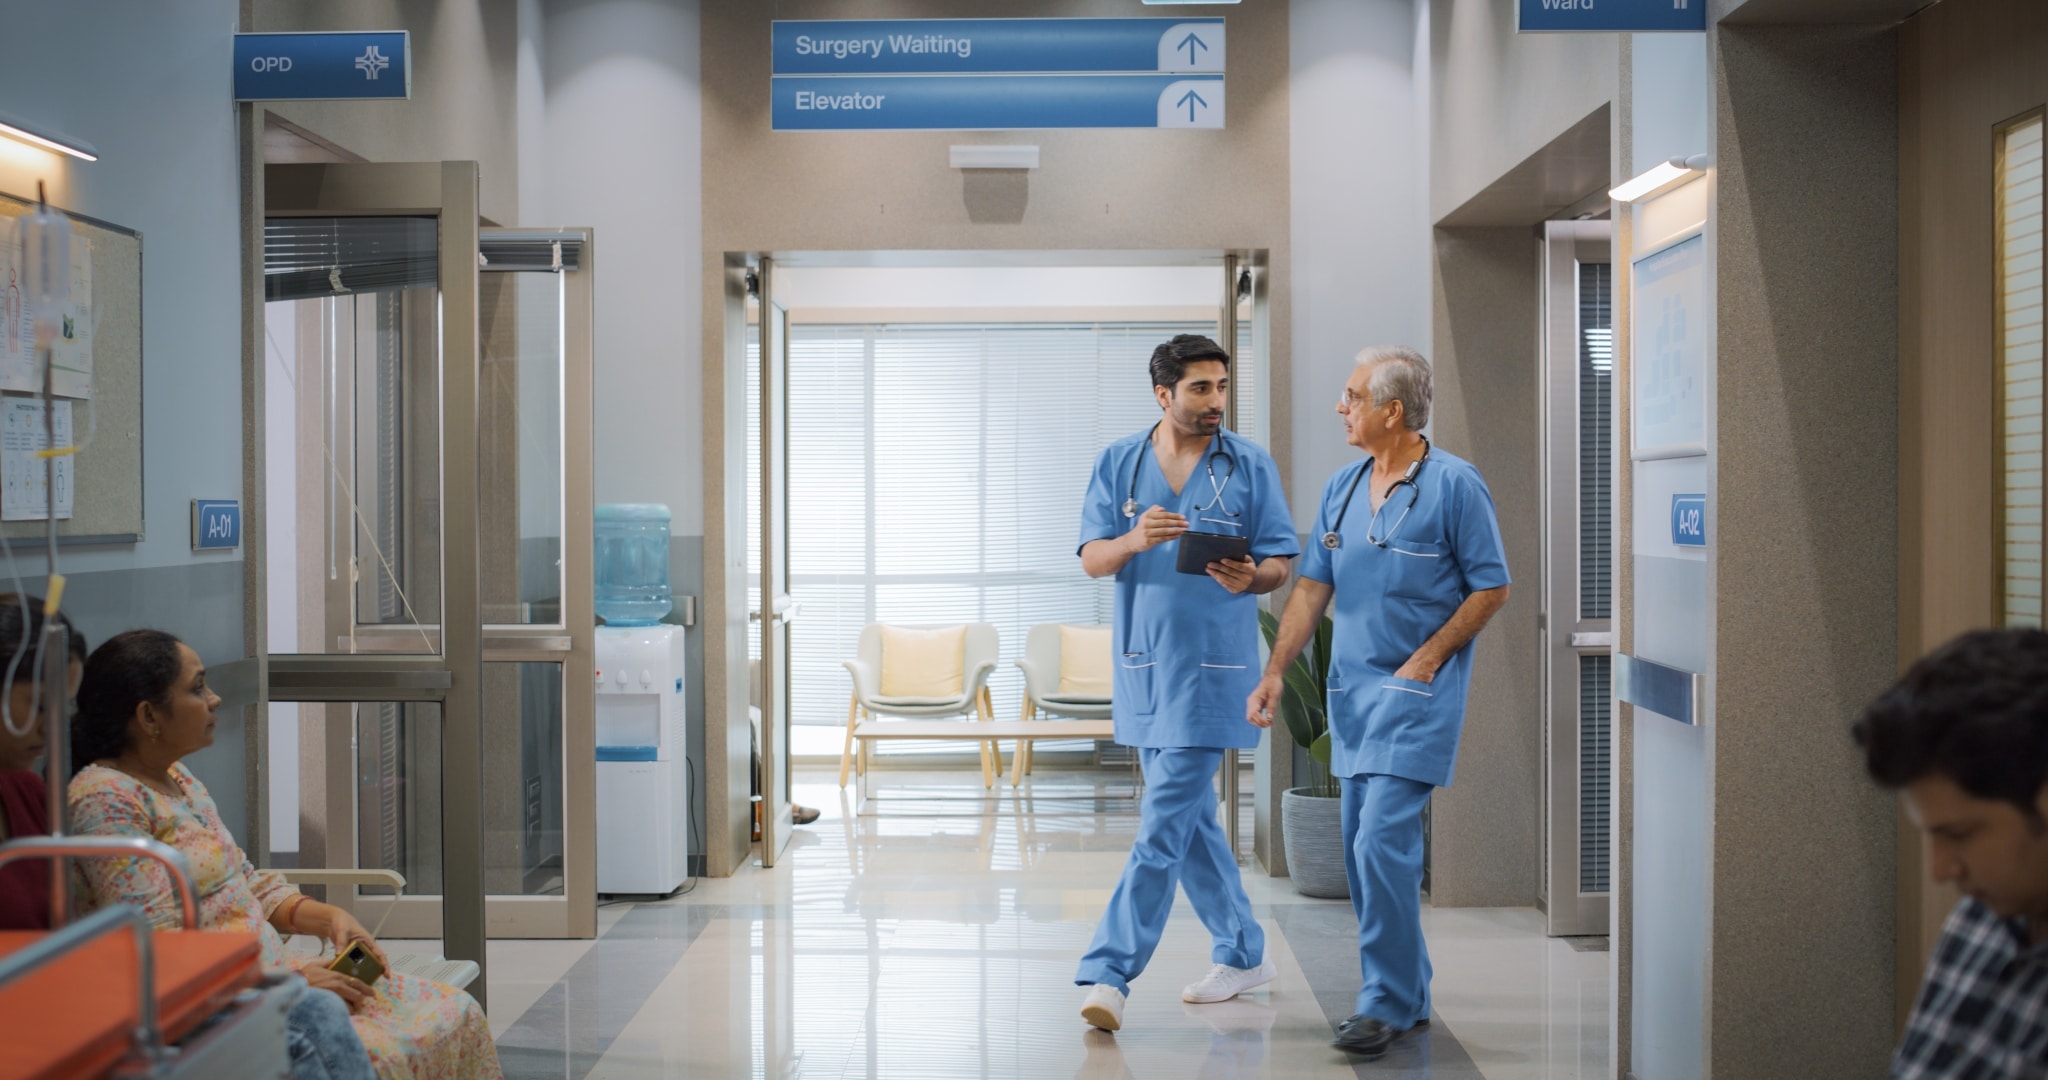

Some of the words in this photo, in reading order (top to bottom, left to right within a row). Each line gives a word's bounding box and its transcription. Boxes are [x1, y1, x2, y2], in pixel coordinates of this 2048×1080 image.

[796, 35, 884, 59] Surgery
[888, 34, 972, 58] Waiting
[251, 56, 293, 73] OPD
[795, 91, 885, 110] Elevator
[208, 514, 232, 538] A-01
[1679, 509, 1700, 536] A-02
